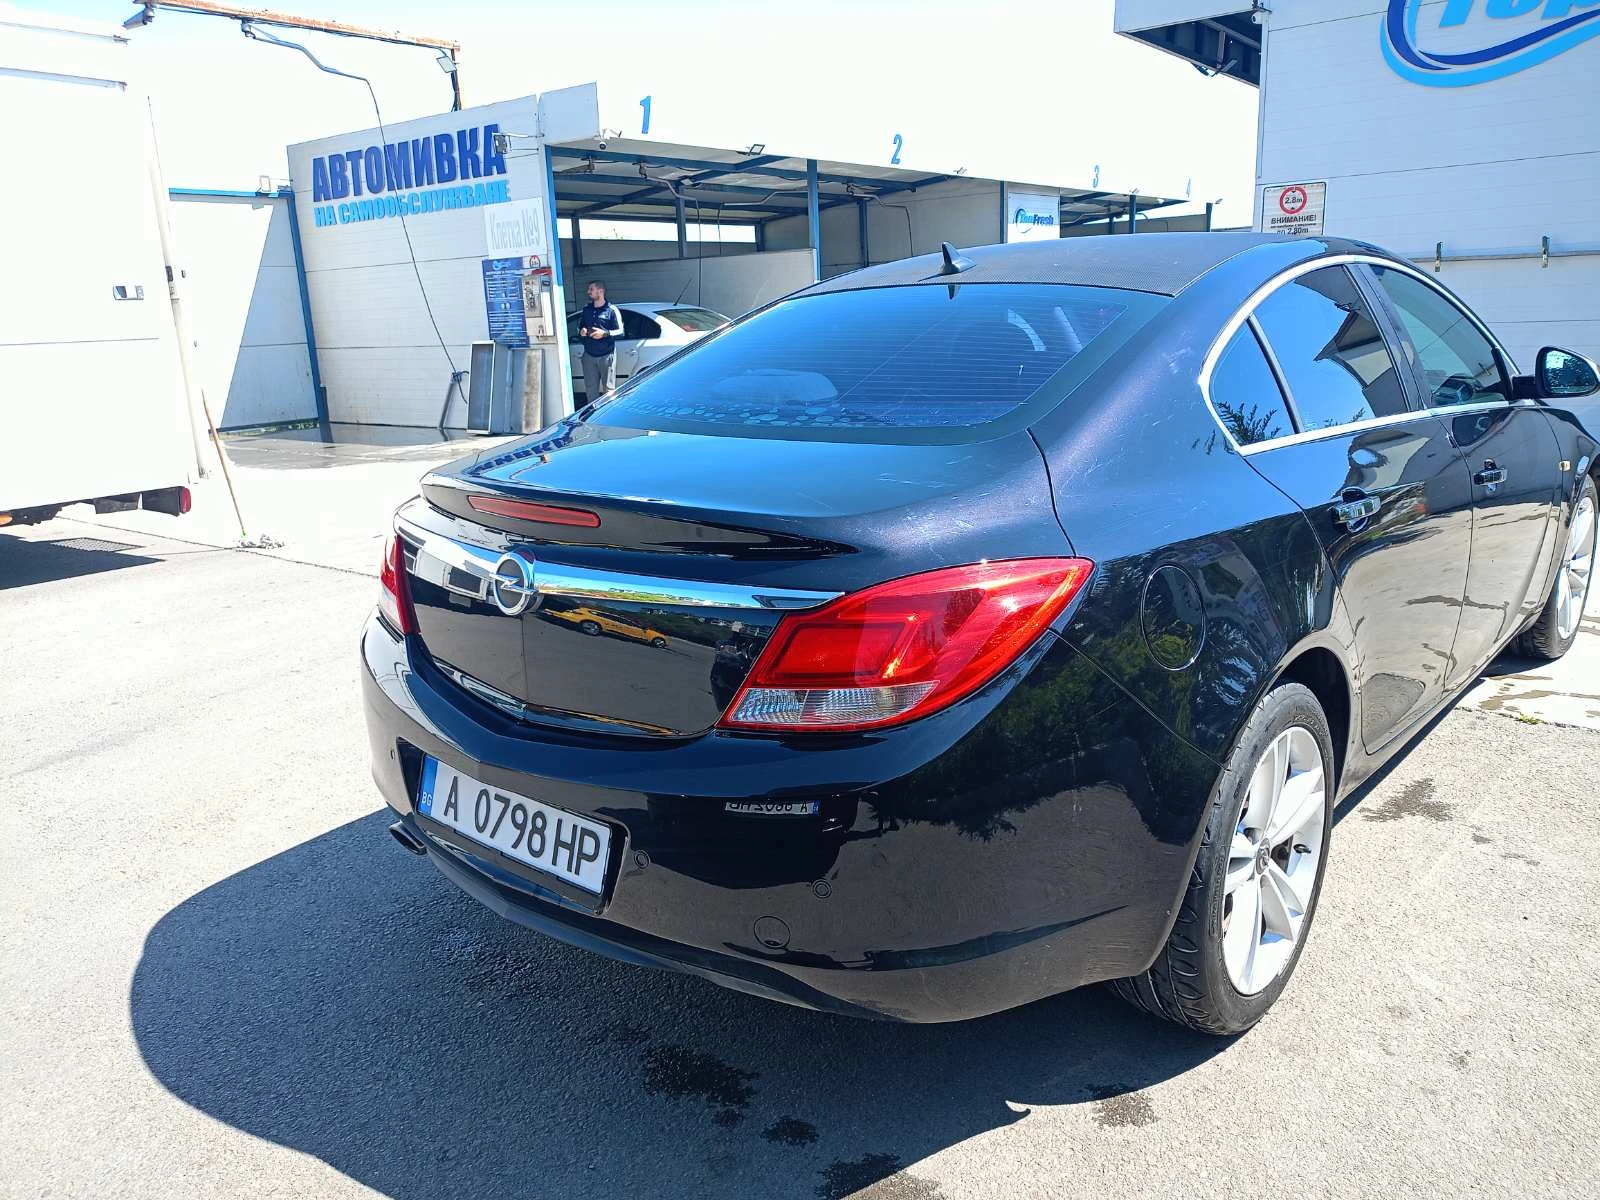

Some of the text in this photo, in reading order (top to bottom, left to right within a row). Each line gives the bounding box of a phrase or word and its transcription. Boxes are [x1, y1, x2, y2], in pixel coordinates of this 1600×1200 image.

[639, 95, 652, 135] 1
[313, 123, 507, 203] АВТОМИВКА
[890, 133, 903, 165] 2
[1092, 164, 1100, 188] 3
[313, 179, 512, 228] НА САМООБСЛУЖВАНЕ
[422, 791, 433, 806] BG
[443, 775, 600, 877] A 0798 HP
